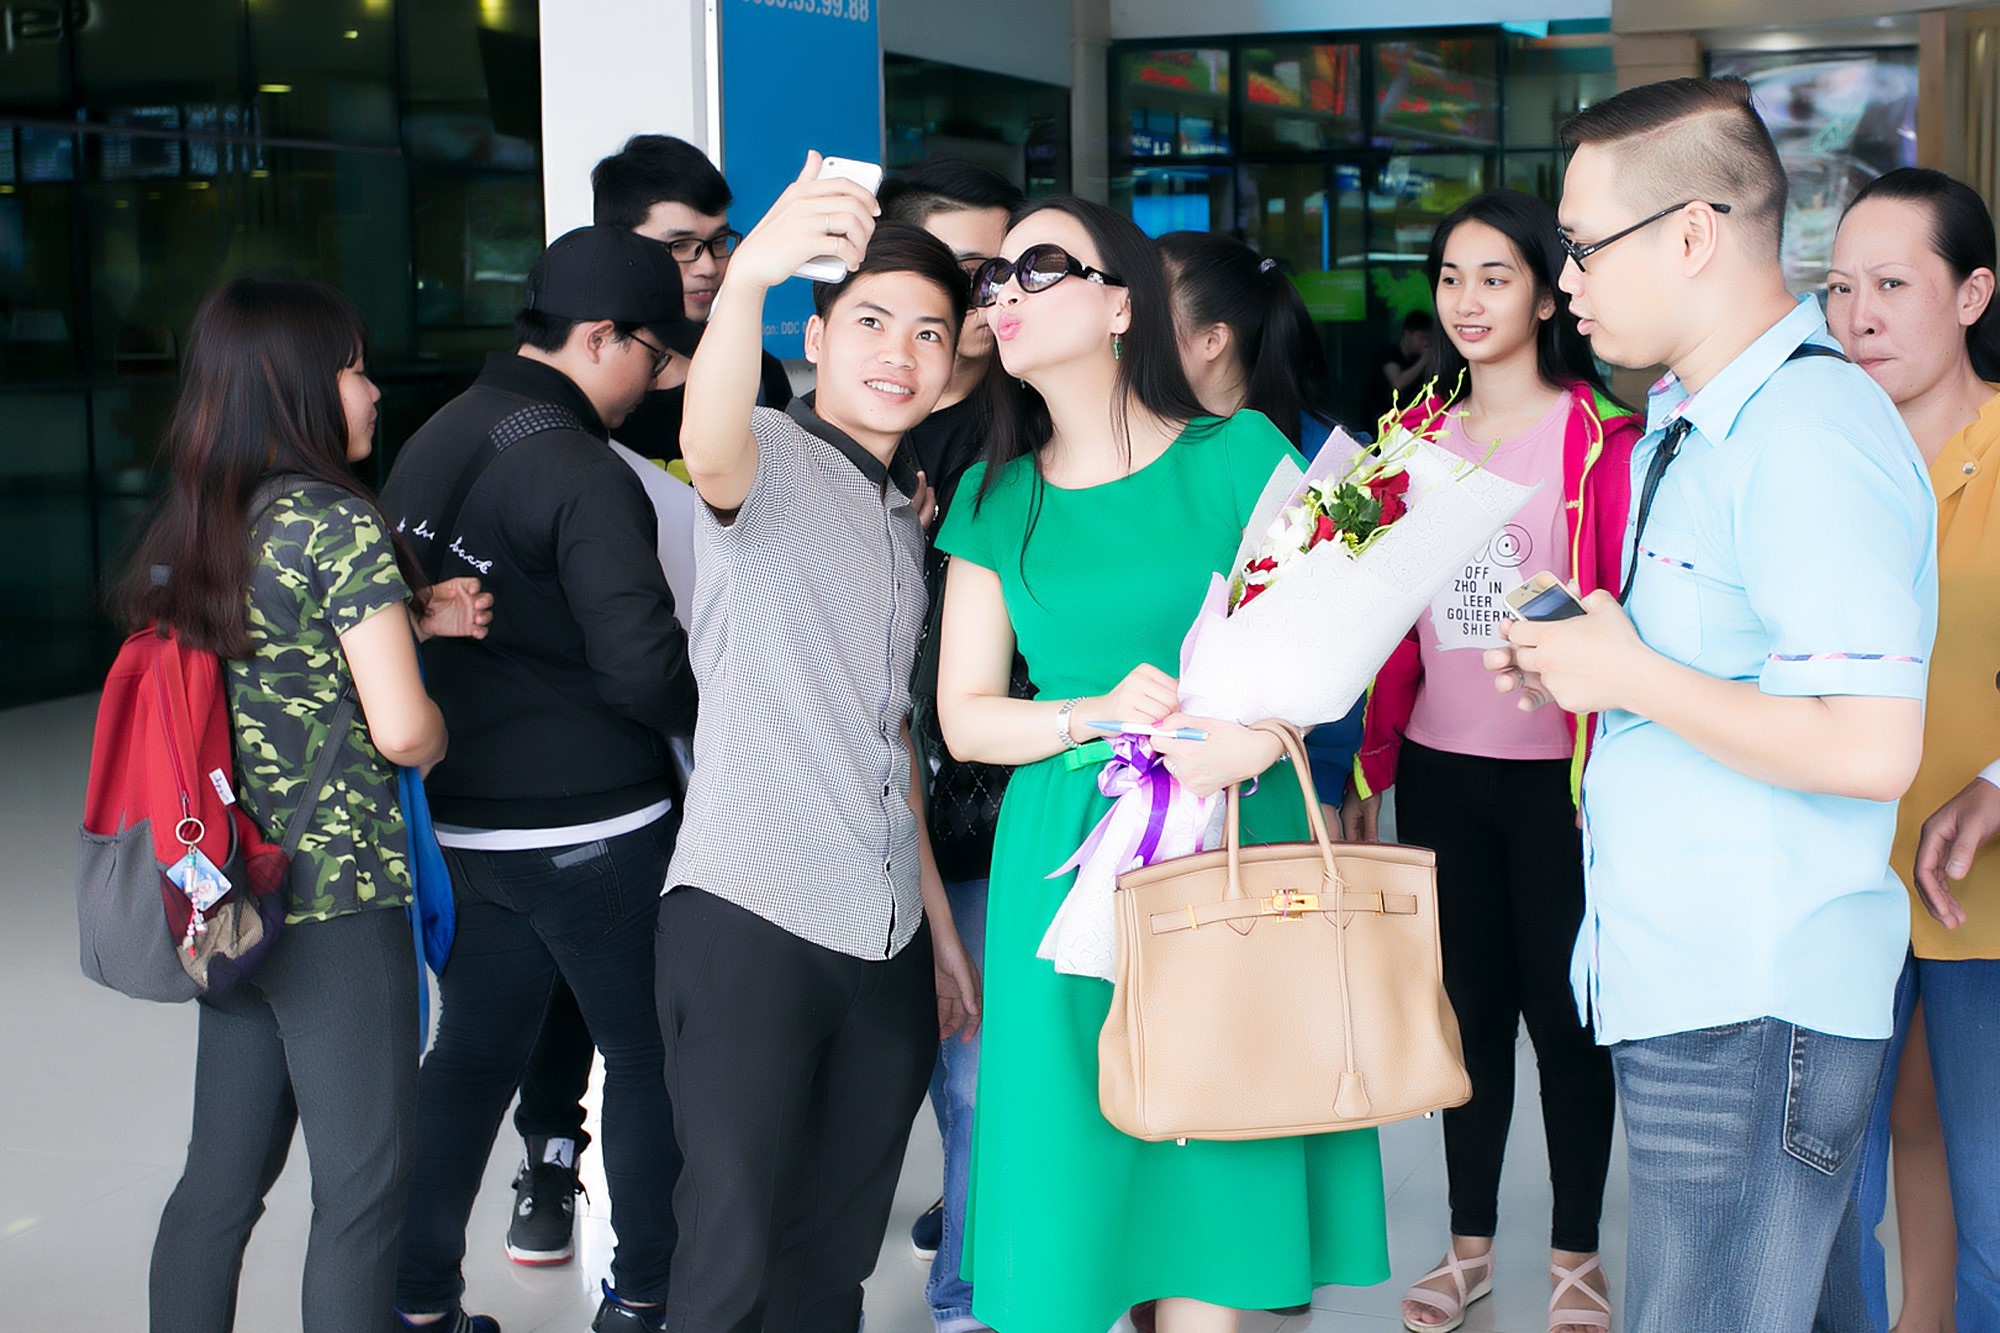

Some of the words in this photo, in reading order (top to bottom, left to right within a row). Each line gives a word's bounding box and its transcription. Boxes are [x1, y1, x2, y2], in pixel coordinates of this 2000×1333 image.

[1465, 565, 1489, 580] OFF
[1454, 579, 1477, 594] ZHO
[1489, 581, 1502, 594] IN
[1463, 594, 1492, 608] LEER
[1462, 622, 1492, 637] SHIE
